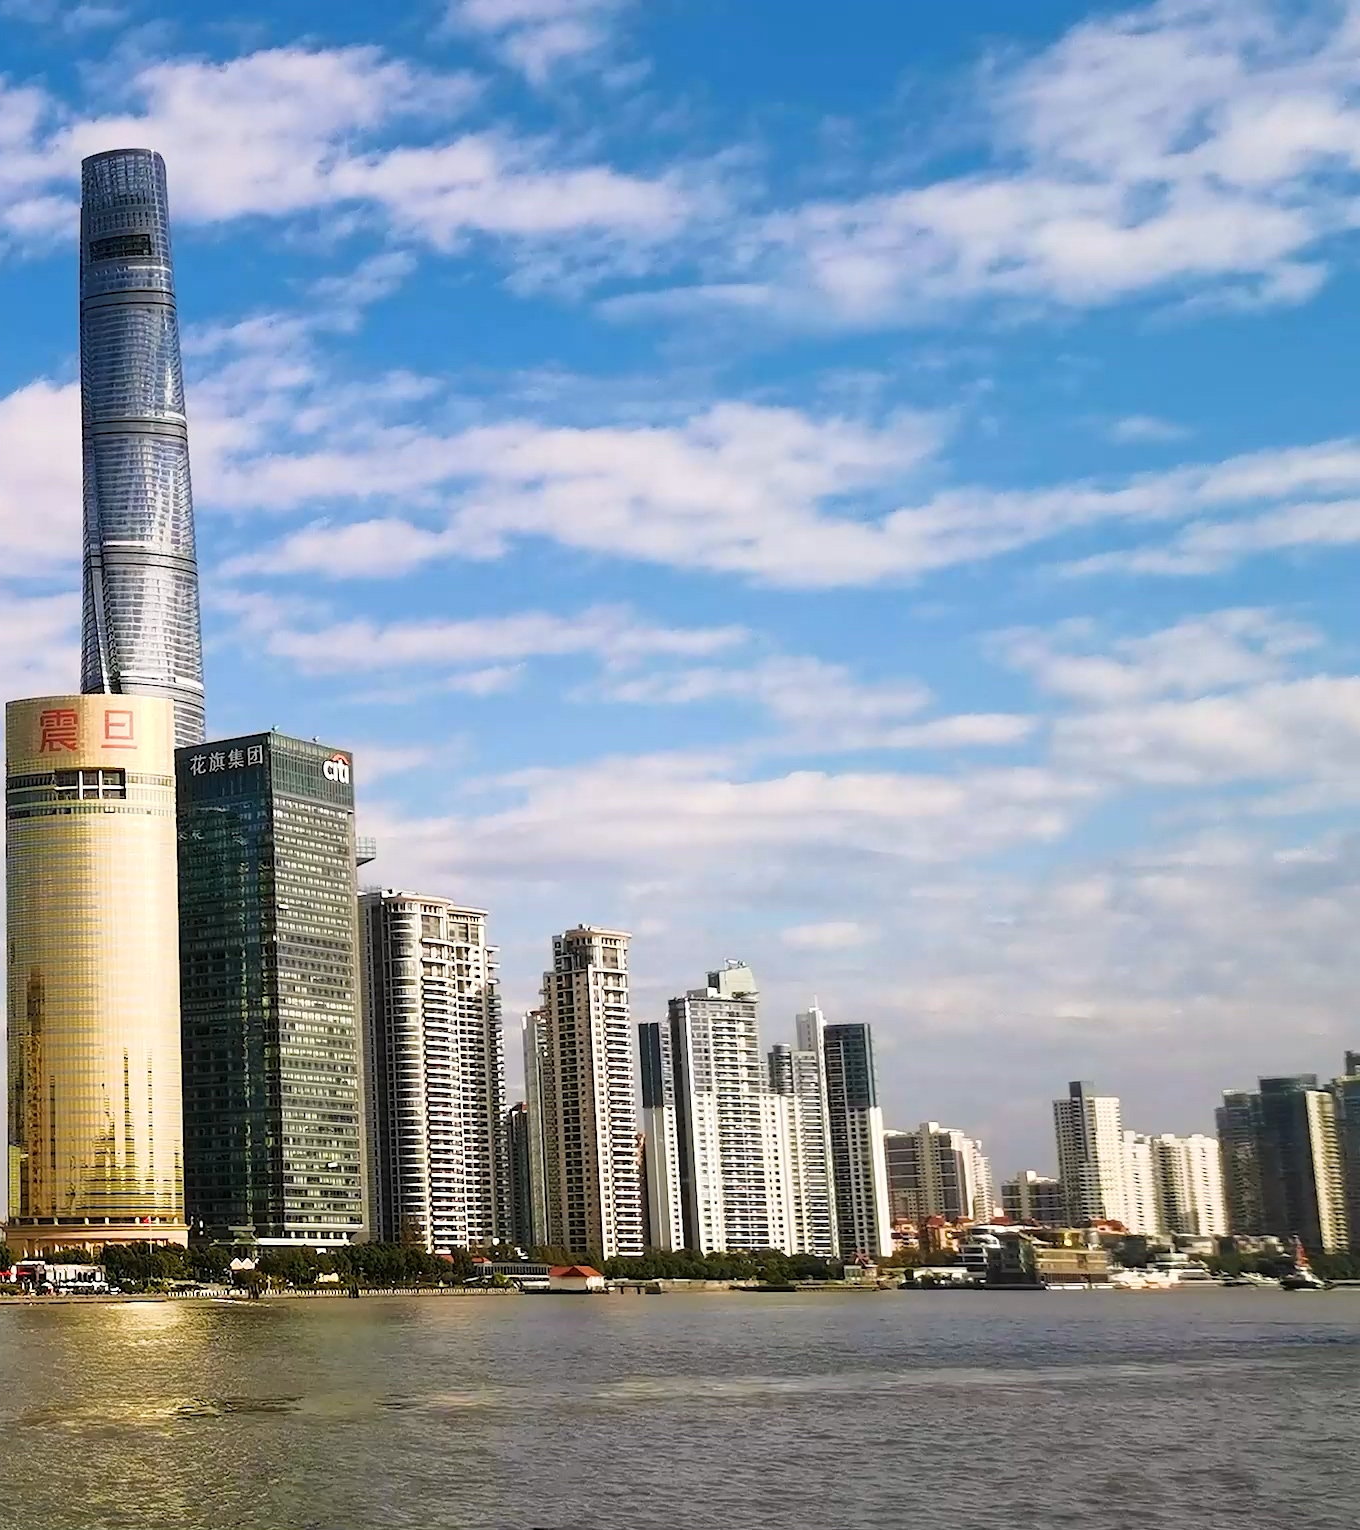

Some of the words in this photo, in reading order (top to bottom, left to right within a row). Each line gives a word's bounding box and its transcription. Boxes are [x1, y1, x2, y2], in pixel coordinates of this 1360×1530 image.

[40, 708, 138, 753] 震旦
[189, 744, 264, 777] 花旗集团
[322, 756, 350, 784] citi
